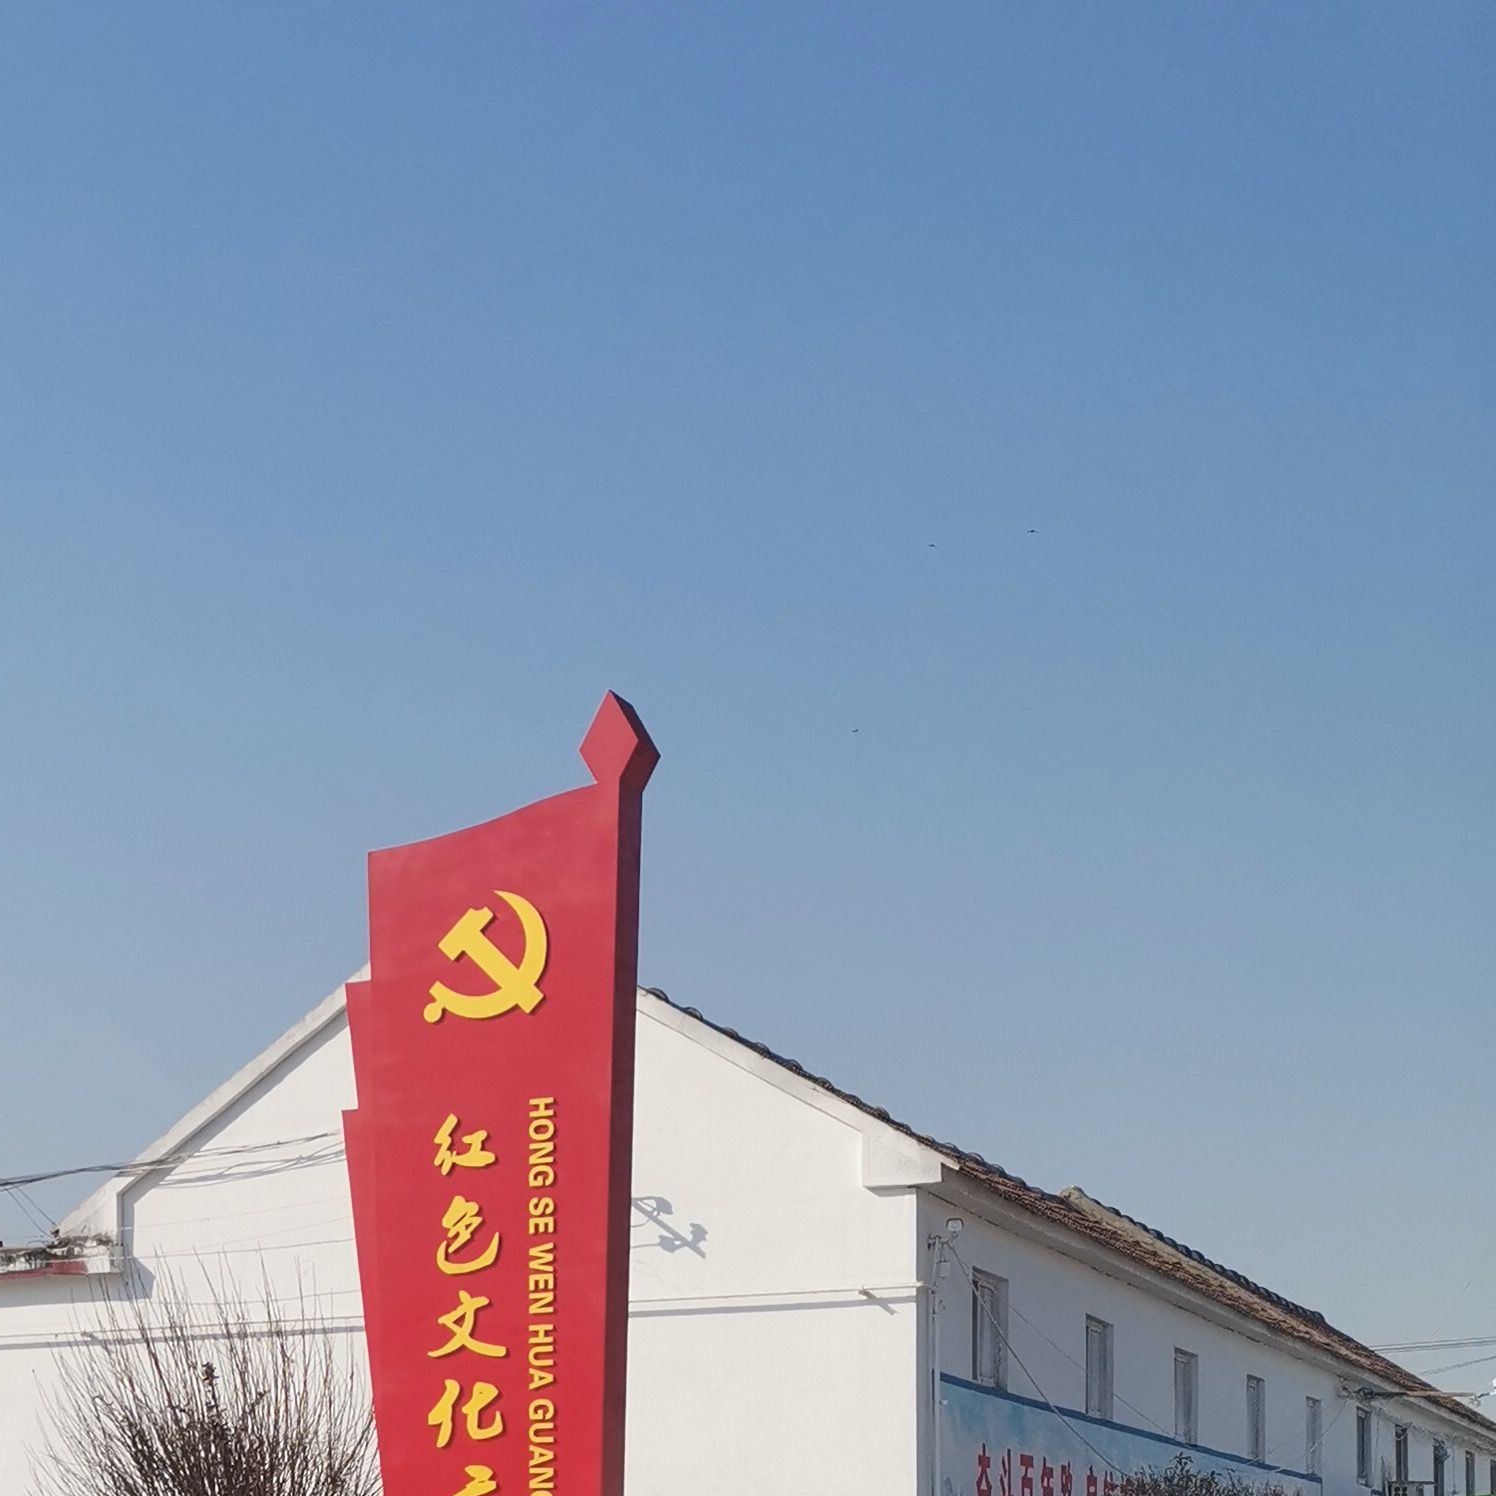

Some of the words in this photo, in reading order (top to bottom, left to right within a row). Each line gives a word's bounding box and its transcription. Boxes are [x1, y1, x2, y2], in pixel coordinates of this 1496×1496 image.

[528, 1096, 555, 1188] HONG
[528, 1197, 555, 1235] SE
[528, 1242, 555, 1315] WEN
[528, 1324, 555, 1391] HUA
